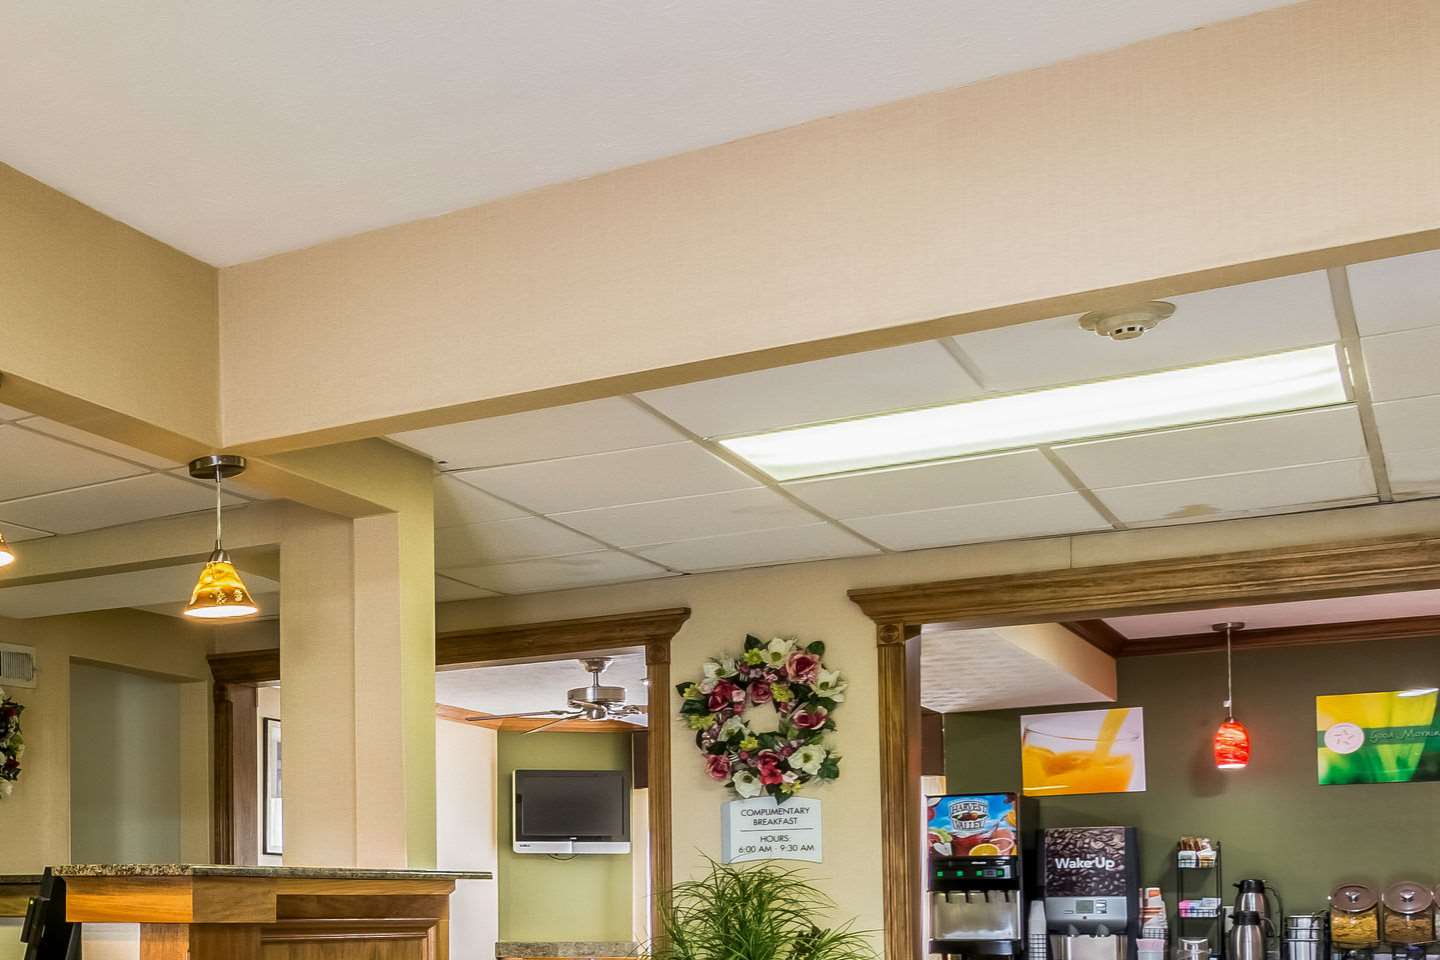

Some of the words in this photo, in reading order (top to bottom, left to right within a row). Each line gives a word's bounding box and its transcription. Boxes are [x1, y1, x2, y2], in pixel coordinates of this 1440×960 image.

[741, 807, 810, 817] COMPLIMENTARY
[753, 817, 798, 826] BREAKFAST
[760, 835, 790, 843] HOURS
[758, 845, 772, 853] AM
[800, 844, 815, 852] AM
